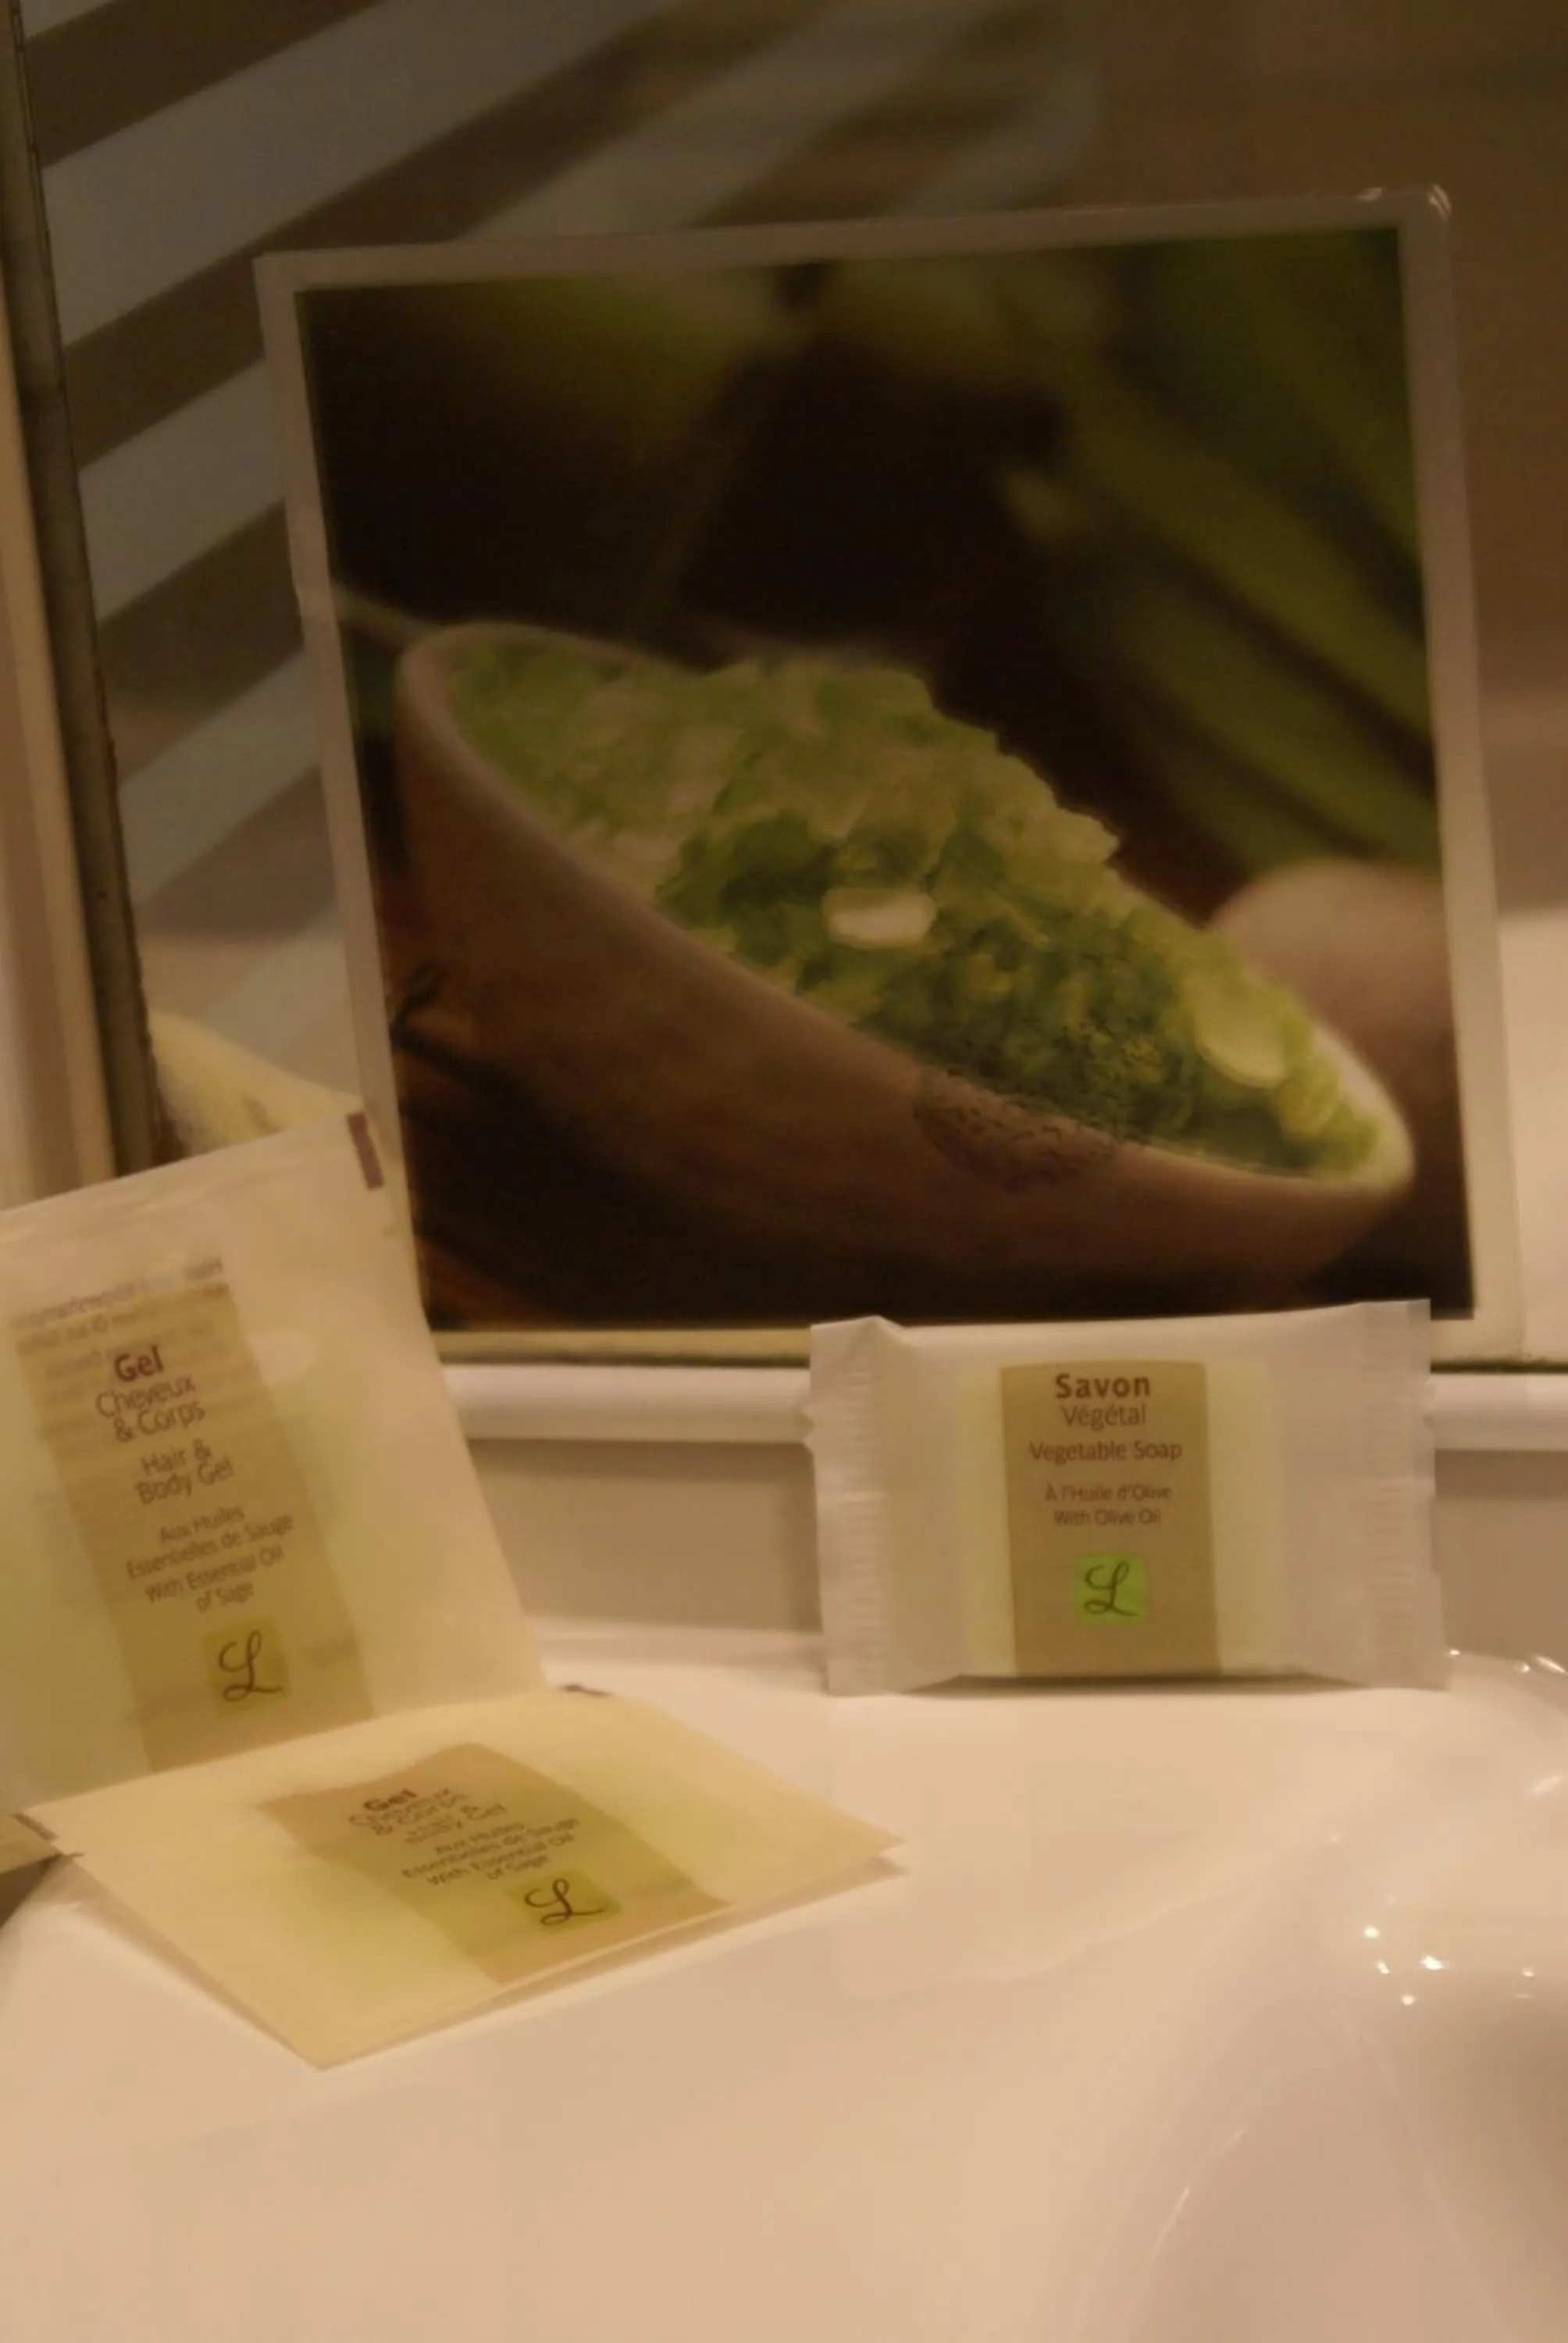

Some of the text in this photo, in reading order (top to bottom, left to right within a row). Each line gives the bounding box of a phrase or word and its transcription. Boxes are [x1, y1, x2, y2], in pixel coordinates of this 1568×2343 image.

[115, 1344, 164, 1382] Gel
[96, 1375, 195, 1417] Cheveux
[1054, 1373, 1150, 1399] Savon
[113, 1401, 205, 1443] & Corps
[1061, 1403, 1146, 1432] Végétal
[141, 1439, 213, 1476] Hair &
[1028, 1440, 1183, 1465] Vegetable Soap
[136, 1457, 233, 1505] Body Gel
[1053, 1508, 1161, 1525] With Olive Oil
[363, 1787, 419, 1811] Gel
